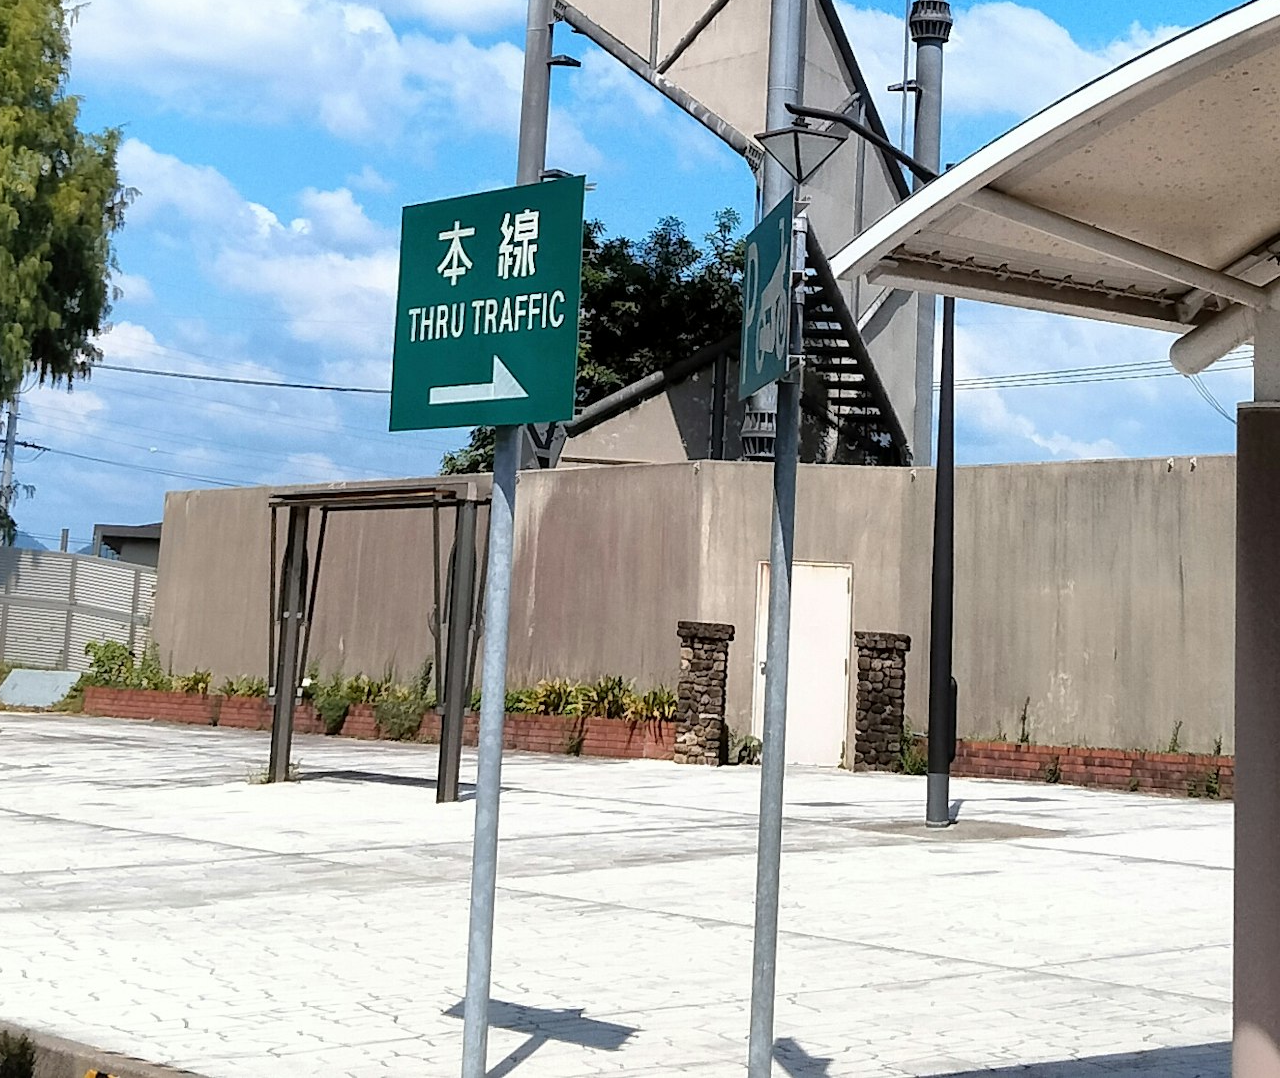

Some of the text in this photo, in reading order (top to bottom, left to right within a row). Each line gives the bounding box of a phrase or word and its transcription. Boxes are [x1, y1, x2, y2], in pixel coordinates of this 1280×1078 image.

[436, 208, 540, 286] 本線
[408, 289, 566, 342] THRU TRAFFIC
